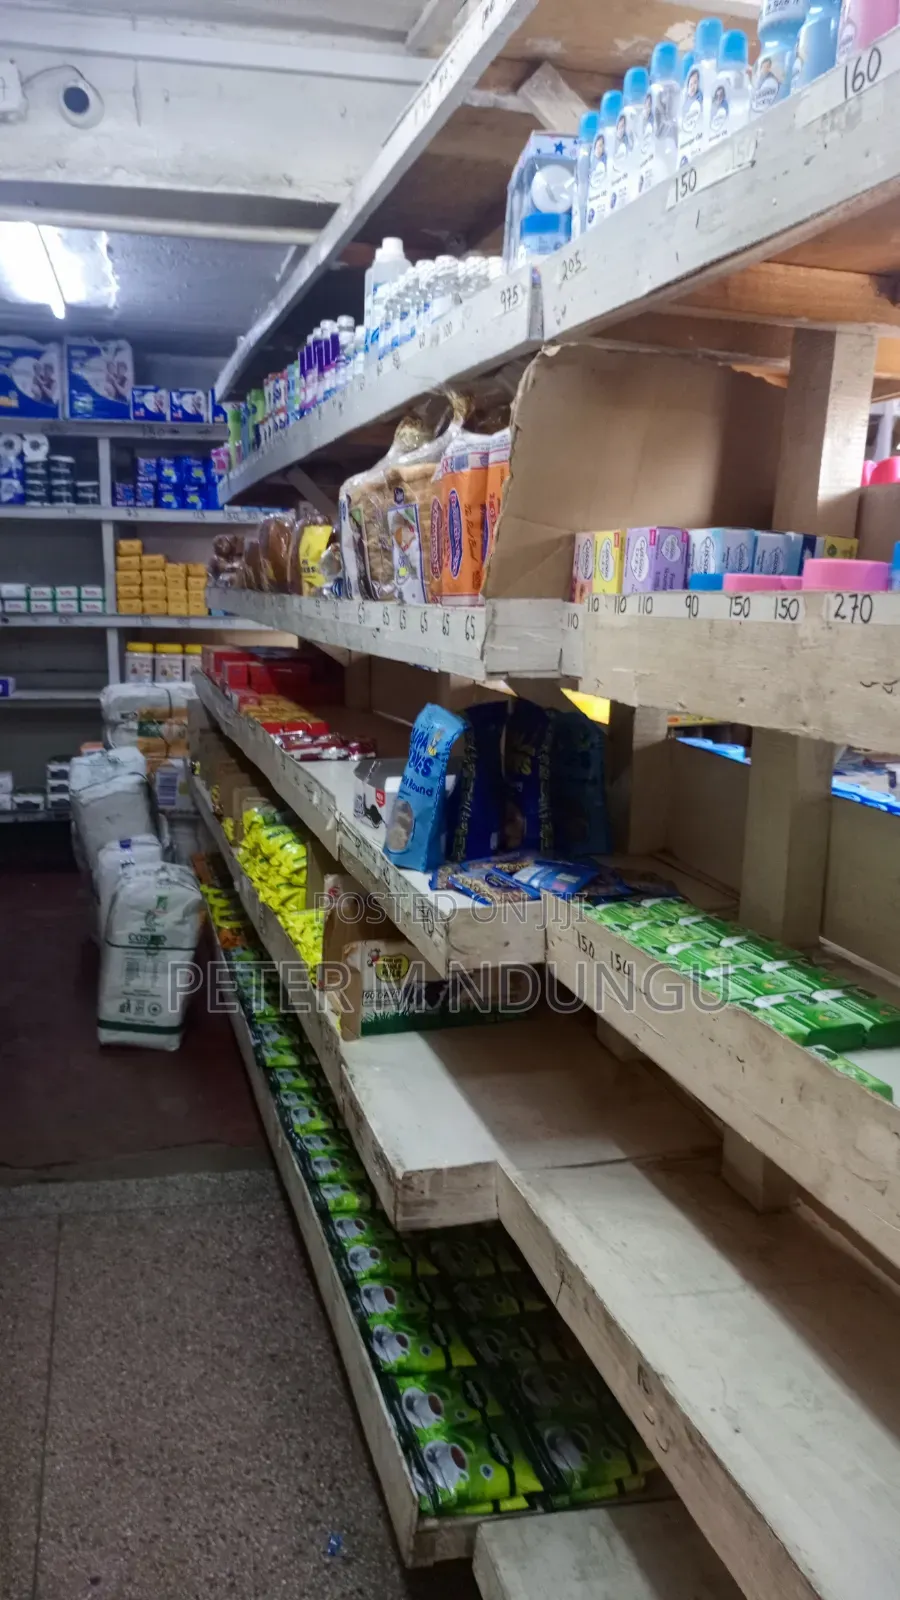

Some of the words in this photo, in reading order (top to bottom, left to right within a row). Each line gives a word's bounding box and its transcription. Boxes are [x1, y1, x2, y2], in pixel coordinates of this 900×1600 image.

[844, 46, 882, 101] 160
[674, 168, 698, 203] 150
[562, 250, 583, 281] 205
[500, 285, 519, 314] 975
[587, 596, 600, 613] 110
[614, 596, 627, 615] 110
[638, 595, 653, 614] 110
[685, 594, 699, 619] 90
[729, 595, 751, 619] 150
[774, 596, 800, 621] 150
[834, 593, 873, 624] 270
[420, 611, 428, 634] 65
[442, 612, 450, 636] 65
[465, 614, 476, 641] 65
[567, 612, 579, 630] 110
[576, 931, 596, 959] 150
